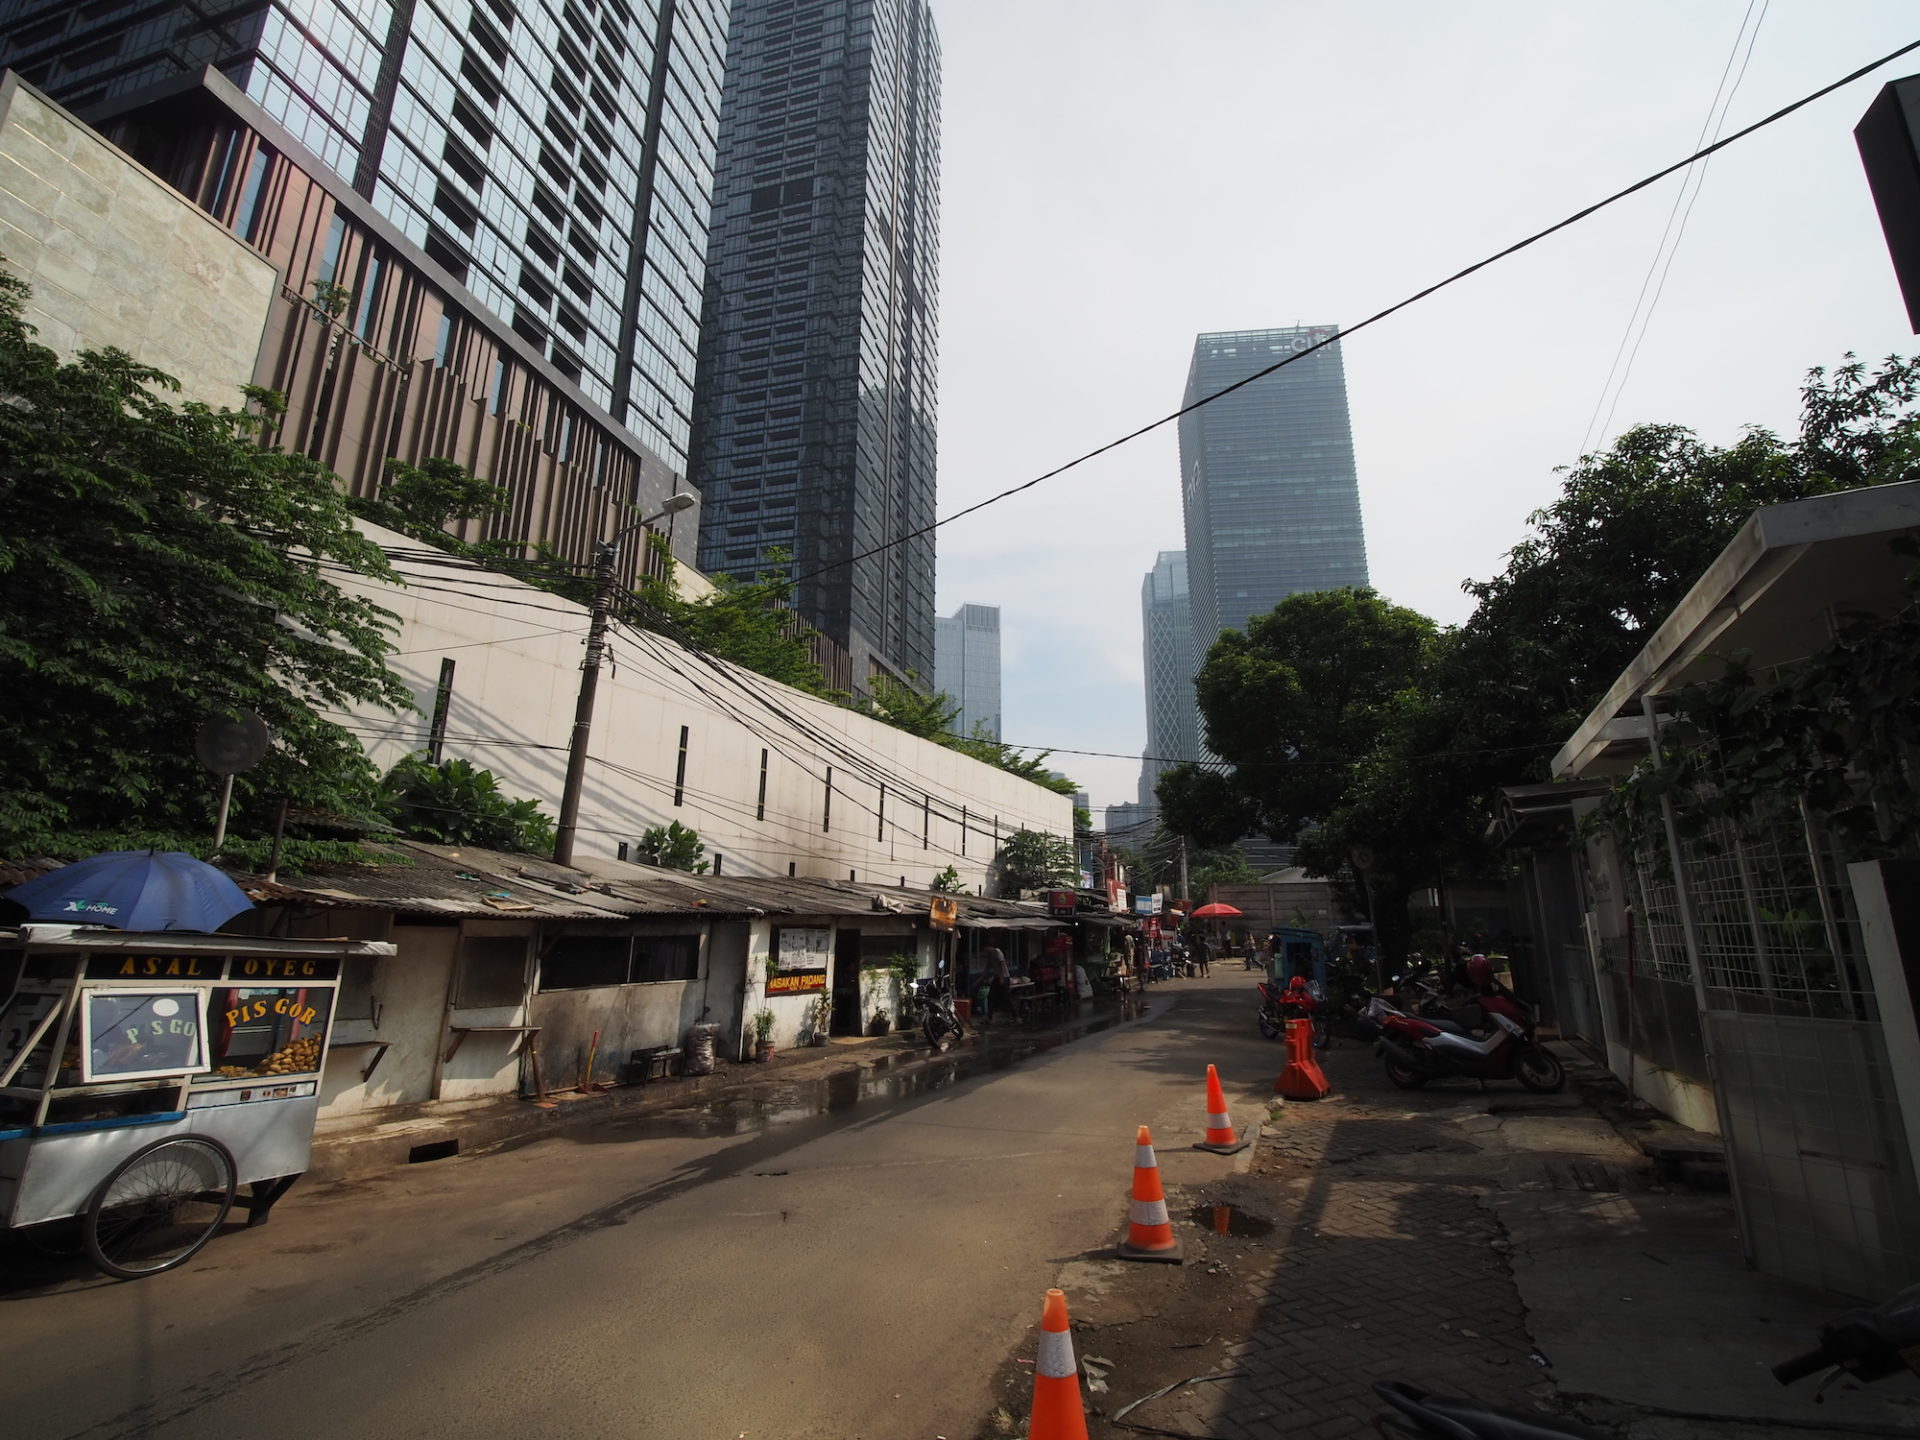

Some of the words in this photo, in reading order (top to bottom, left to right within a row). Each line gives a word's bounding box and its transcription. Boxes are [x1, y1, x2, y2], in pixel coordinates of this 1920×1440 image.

[85, 904, 118, 915] HOME
[119, 957, 202, 976] ASAL
[244, 958, 316, 976] OYEG
[801, 974, 826, 986] PADANG
[225, 1000, 269, 1028] PIS
[274, 998, 317, 1026] GOR
